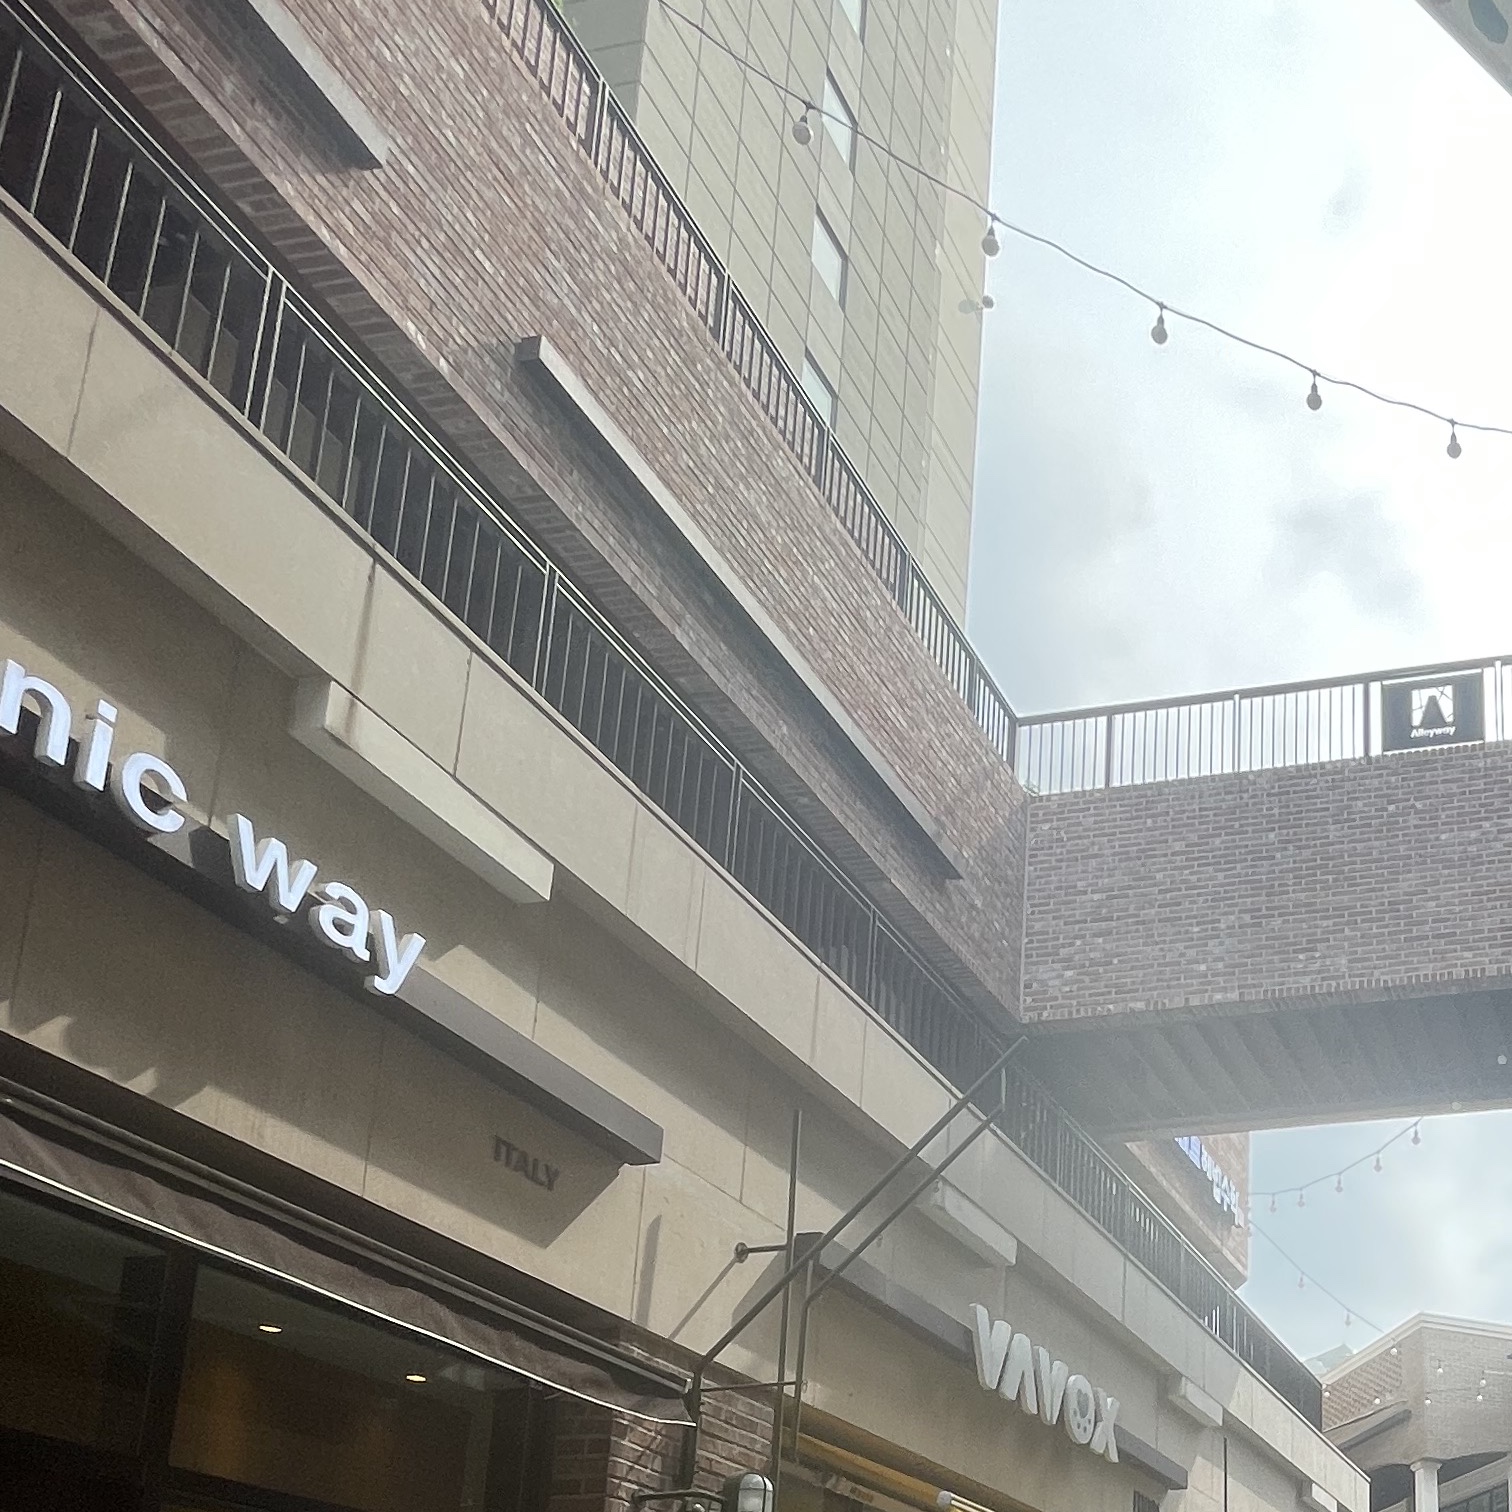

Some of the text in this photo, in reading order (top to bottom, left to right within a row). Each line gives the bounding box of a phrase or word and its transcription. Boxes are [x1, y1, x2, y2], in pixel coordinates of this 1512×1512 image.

[1410, 725, 1456, 740] Alleyway
[229, 813, 427, 995] way
[494, 1135, 560, 1192] ITALY
